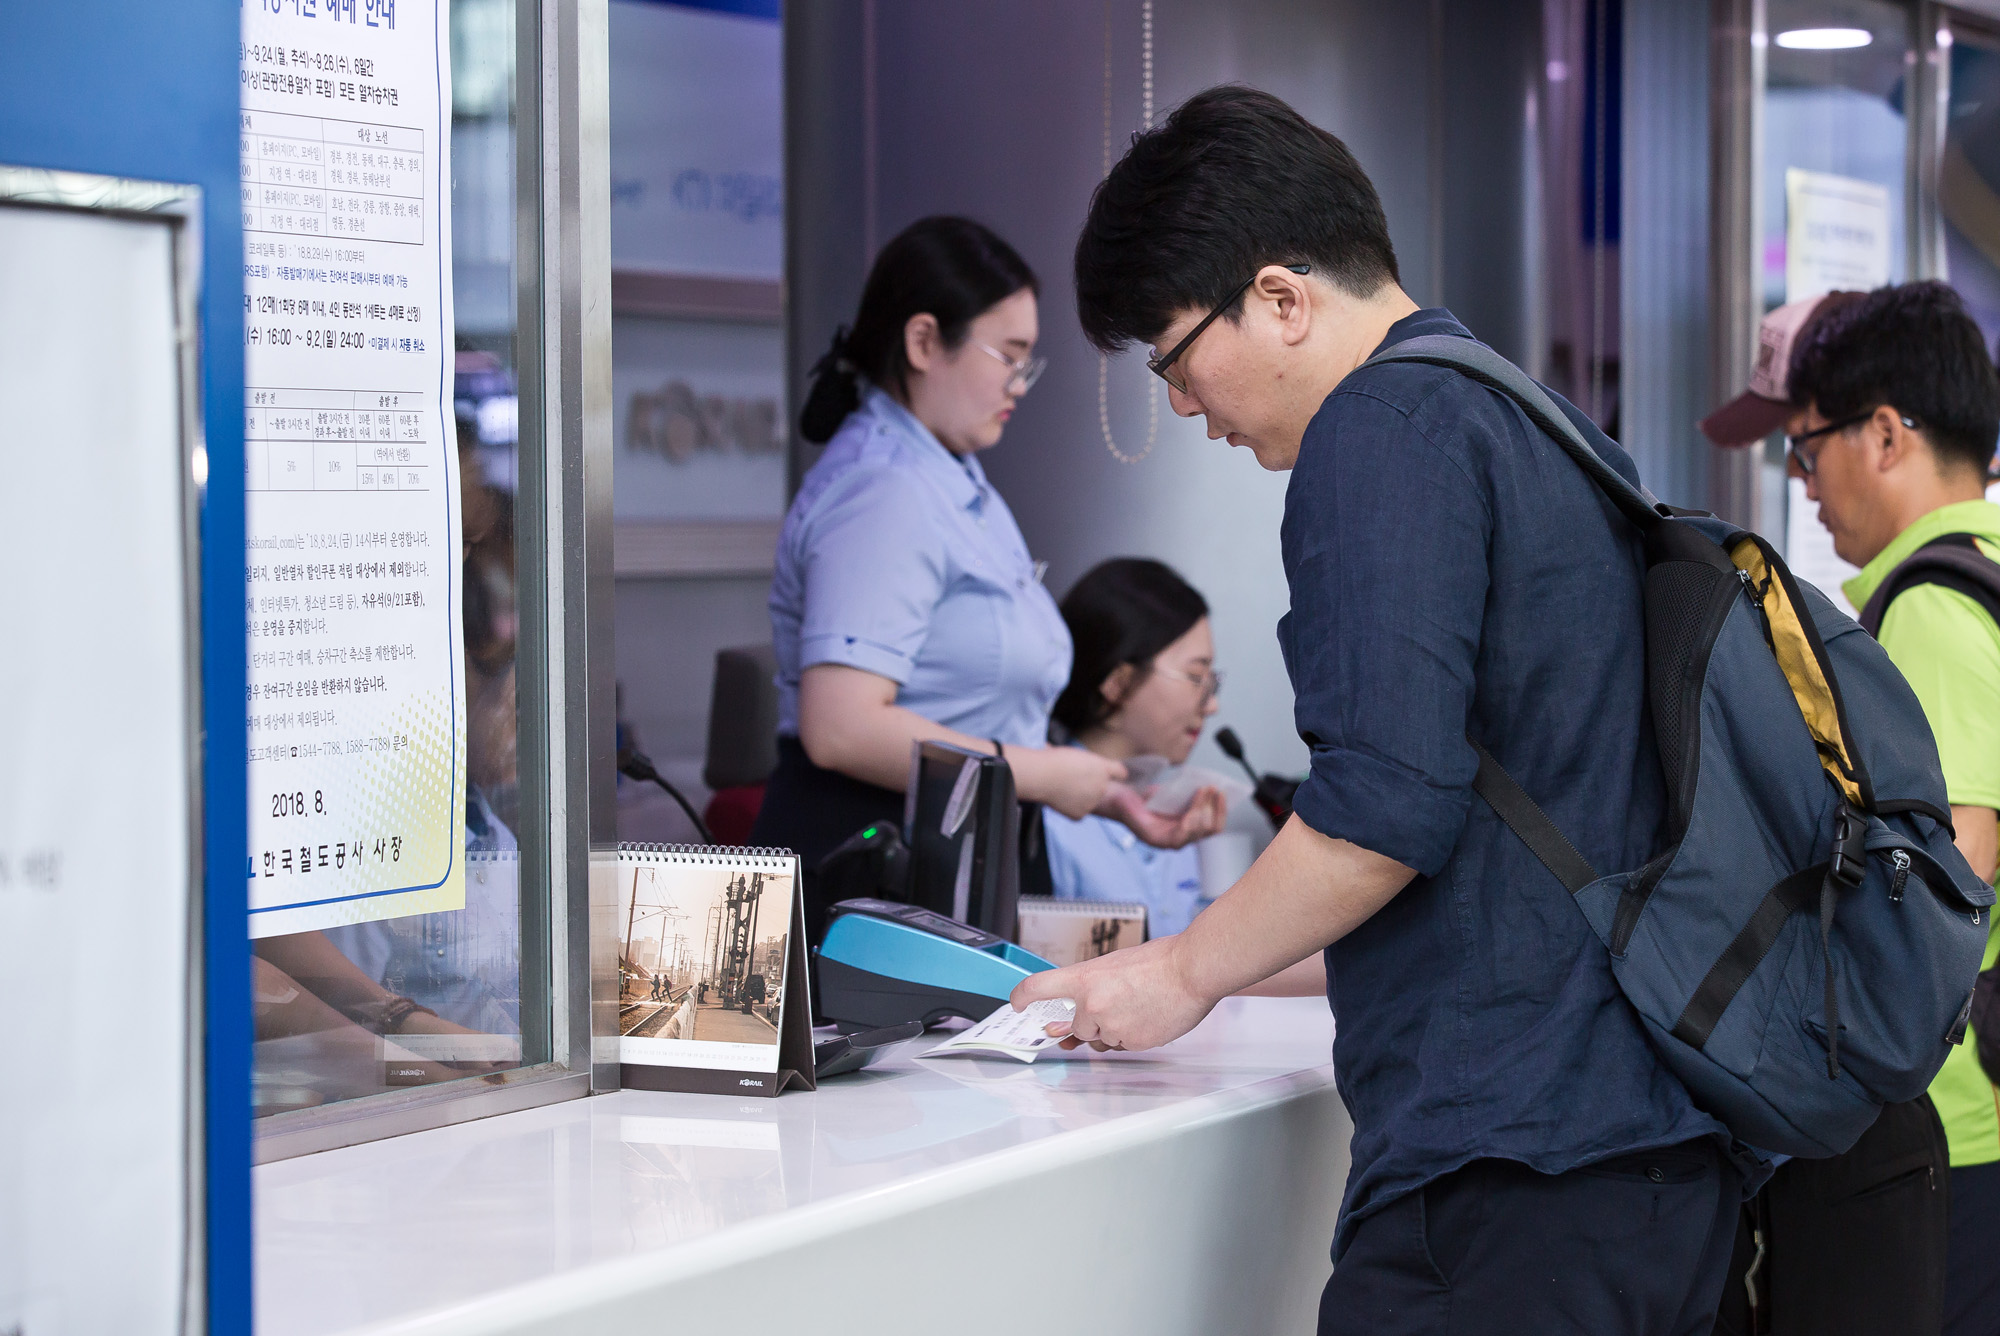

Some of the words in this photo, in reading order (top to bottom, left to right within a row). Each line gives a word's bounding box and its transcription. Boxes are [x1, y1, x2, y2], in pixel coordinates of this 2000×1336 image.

[355, 58, 374, 78] 6일간
[241, 70, 311, 95] 이상(관광전용열차
[316, 79, 335, 99] 포함)
[340, 83, 355, 101] 모든
[360, 85, 398, 106] 열차승차권
[358, 129, 371, 142] 대상
[376, 131, 388, 145] 노선
[301, 146, 322, 161] 모바일)
[303, 194, 323, 208] 모바일)
[335, 250, 365, 264] 16:00부터
[276, 267, 327, 283] 자동발매기에서는
[330, 269, 349, 285] 잔여석
[351, 271, 381, 287] 판매시부터
[383, 273, 395, 287] 예매
[397, 275, 408, 288] 가능
[257, 296, 296, 316] 12매(1회당
[298, 299, 309, 316] 6매
[329, 302, 340, 318] 4인
[343, 303, 362, 319] 동반석
[364, 304, 386, 321] 1세트는
[388, 305, 405, 321] 4매로
[407, 306, 421, 323] 산정)
[267, 329, 292, 346] 16:00
[307, 329, 337, 349] 9.2.(일)
[340, 332, 365, 349] 24:00
[392, 338, 398, 351] 시
[400, 338, 411, 351] 자동
[413, 339, 425, 352] 취소
[328, 461, 341, 472] 10%
[356, 532, 387, 548] 14시부터
[390, 531, 430, 547] 운영합니다.
[274, 564, 304, 581] 일반열차
[307, 564, 336, 581] 할인쿠폰
[339, 563, 353, 579] 적립
[356, 562, 386, 579] 대상에서
[389, 561, 430, 577] 제외합니다.
[304, 595, 326, 612] 청소년
[329, 594, 344, 610] 드림
[262, 620, 285, 636] 운영을
[288, 618, 328, 635] 중지합니다.
[253, 651, 276, 669] 단거리
[278, 650, 293, 667] 구간
[317, 648, 347, 666] 승차구간
[350, 647, 371, 663] 축소를
[375, 644, 416, 661] 제한합니다.
[263, 682, 294, 700] 잔여구간
[296, 681, 319, 697] 운임을
[322, 678, 351, 696] 반환하지
[354, 676, 388, 694] 않습니다.
[264, 713, 294, 731] 대상에서
[297, 710, 338, 727] 제외됩니다.
[346, 739, 390, 754] 1588-7788)
[393, 735, 408, 751] 문의
[272, 791, 308, 818] 2018.
[314, 790, 327, 816] 8.
[264, 841, 364, 878] 한국철도공사
[374, 836, 402, 863] 사장
[739, 1079, 763, 1087] KORAIL
